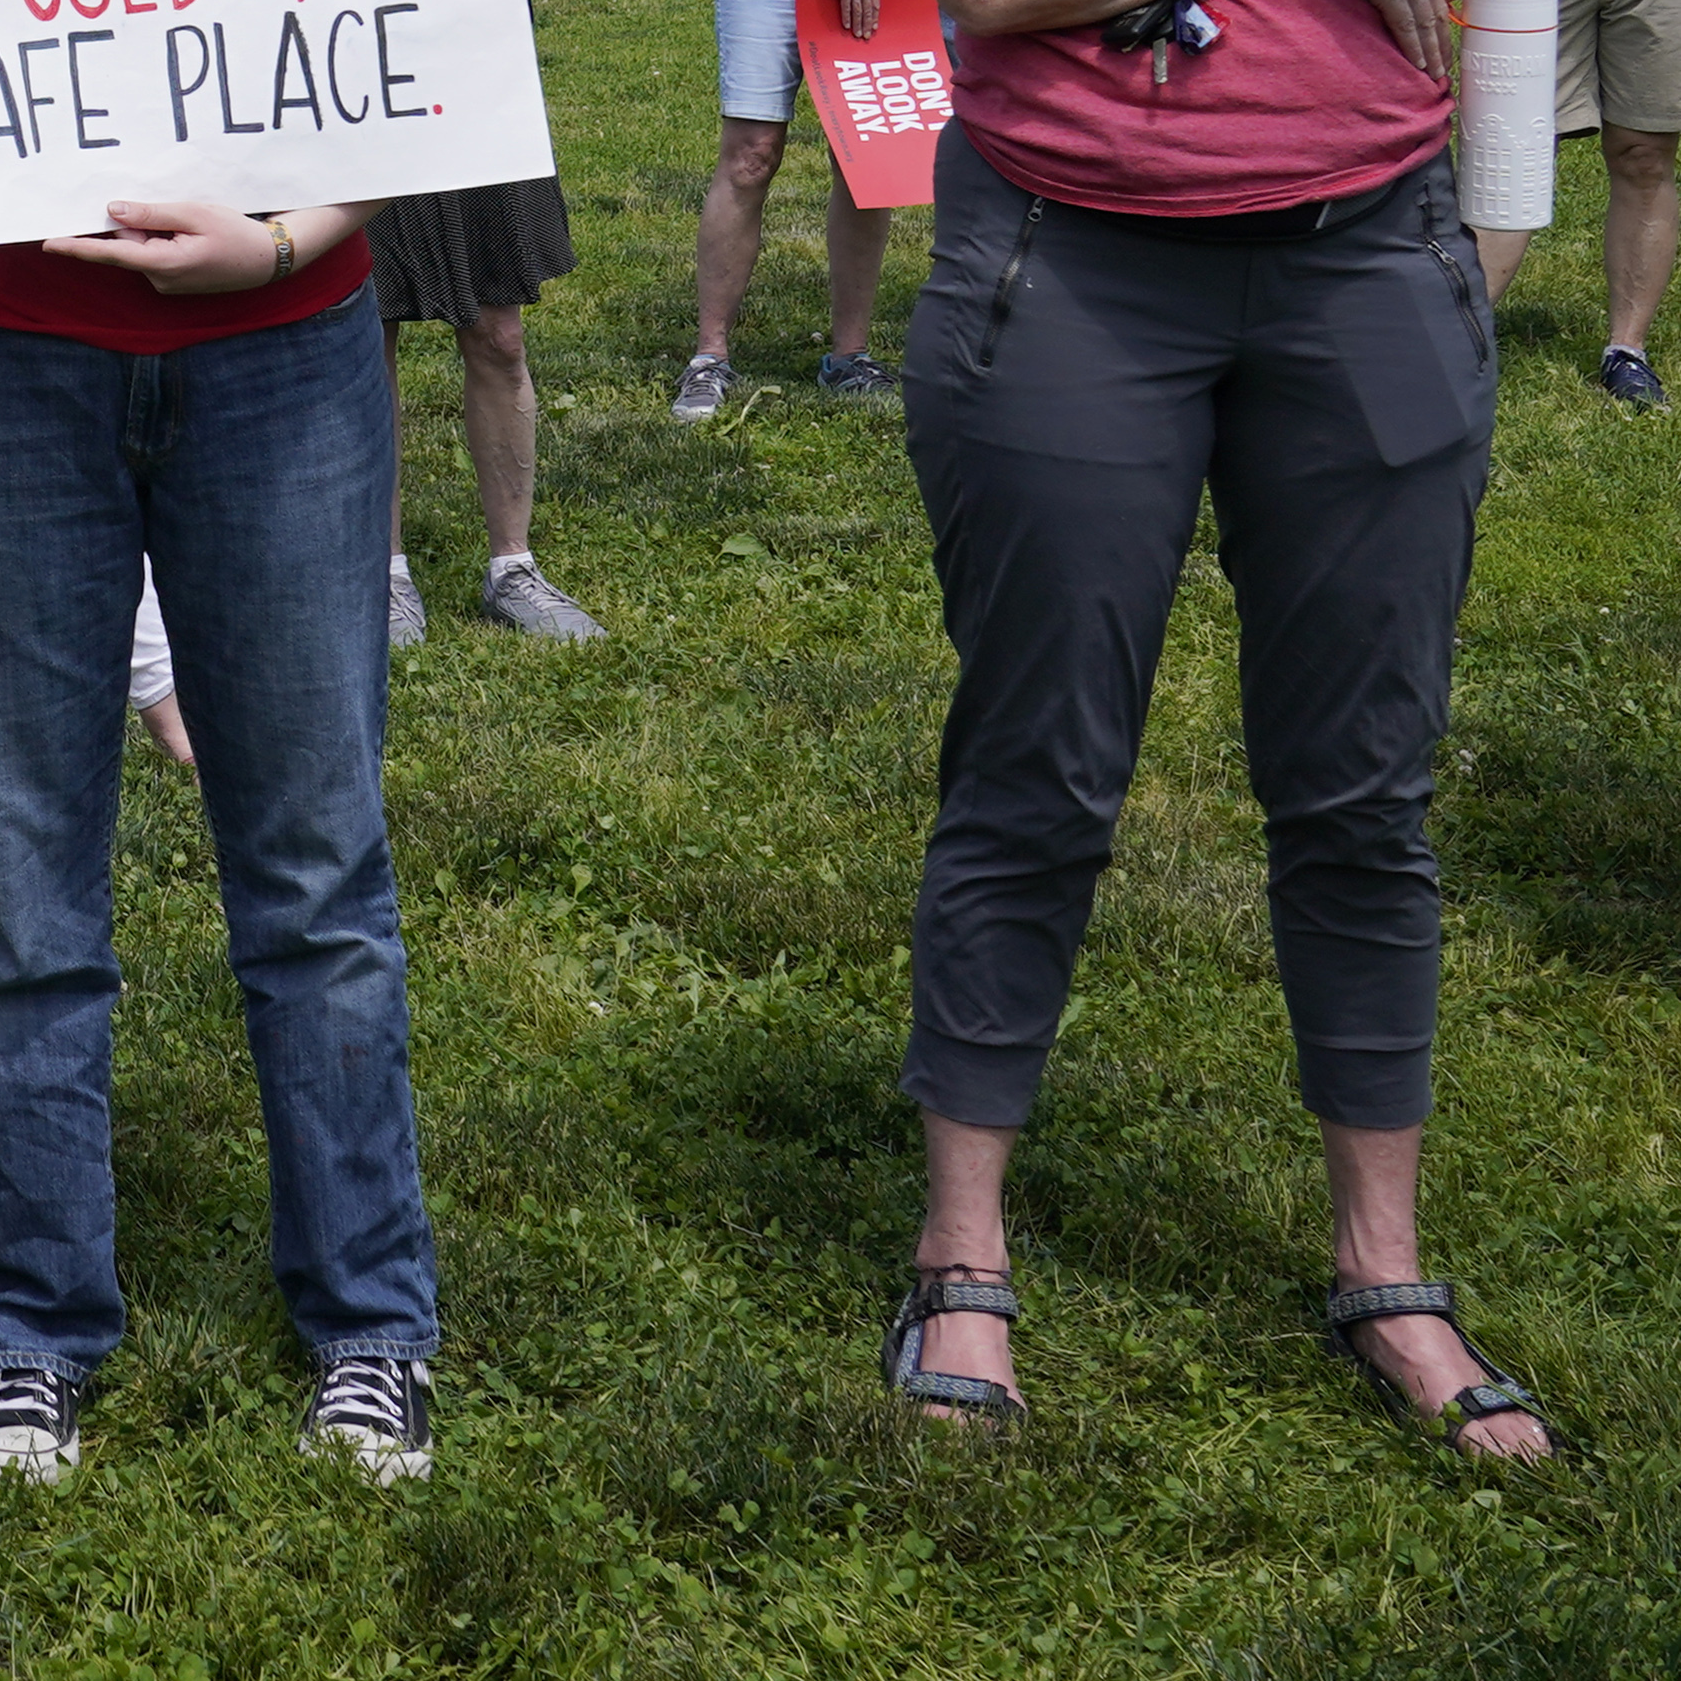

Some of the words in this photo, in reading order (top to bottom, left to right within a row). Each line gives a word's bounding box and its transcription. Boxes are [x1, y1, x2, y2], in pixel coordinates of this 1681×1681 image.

[167, 2, 444, 142] PLACE.
[833, 60, 890, 142] AWAY.
[870, 60, 925, 134] LOOK
